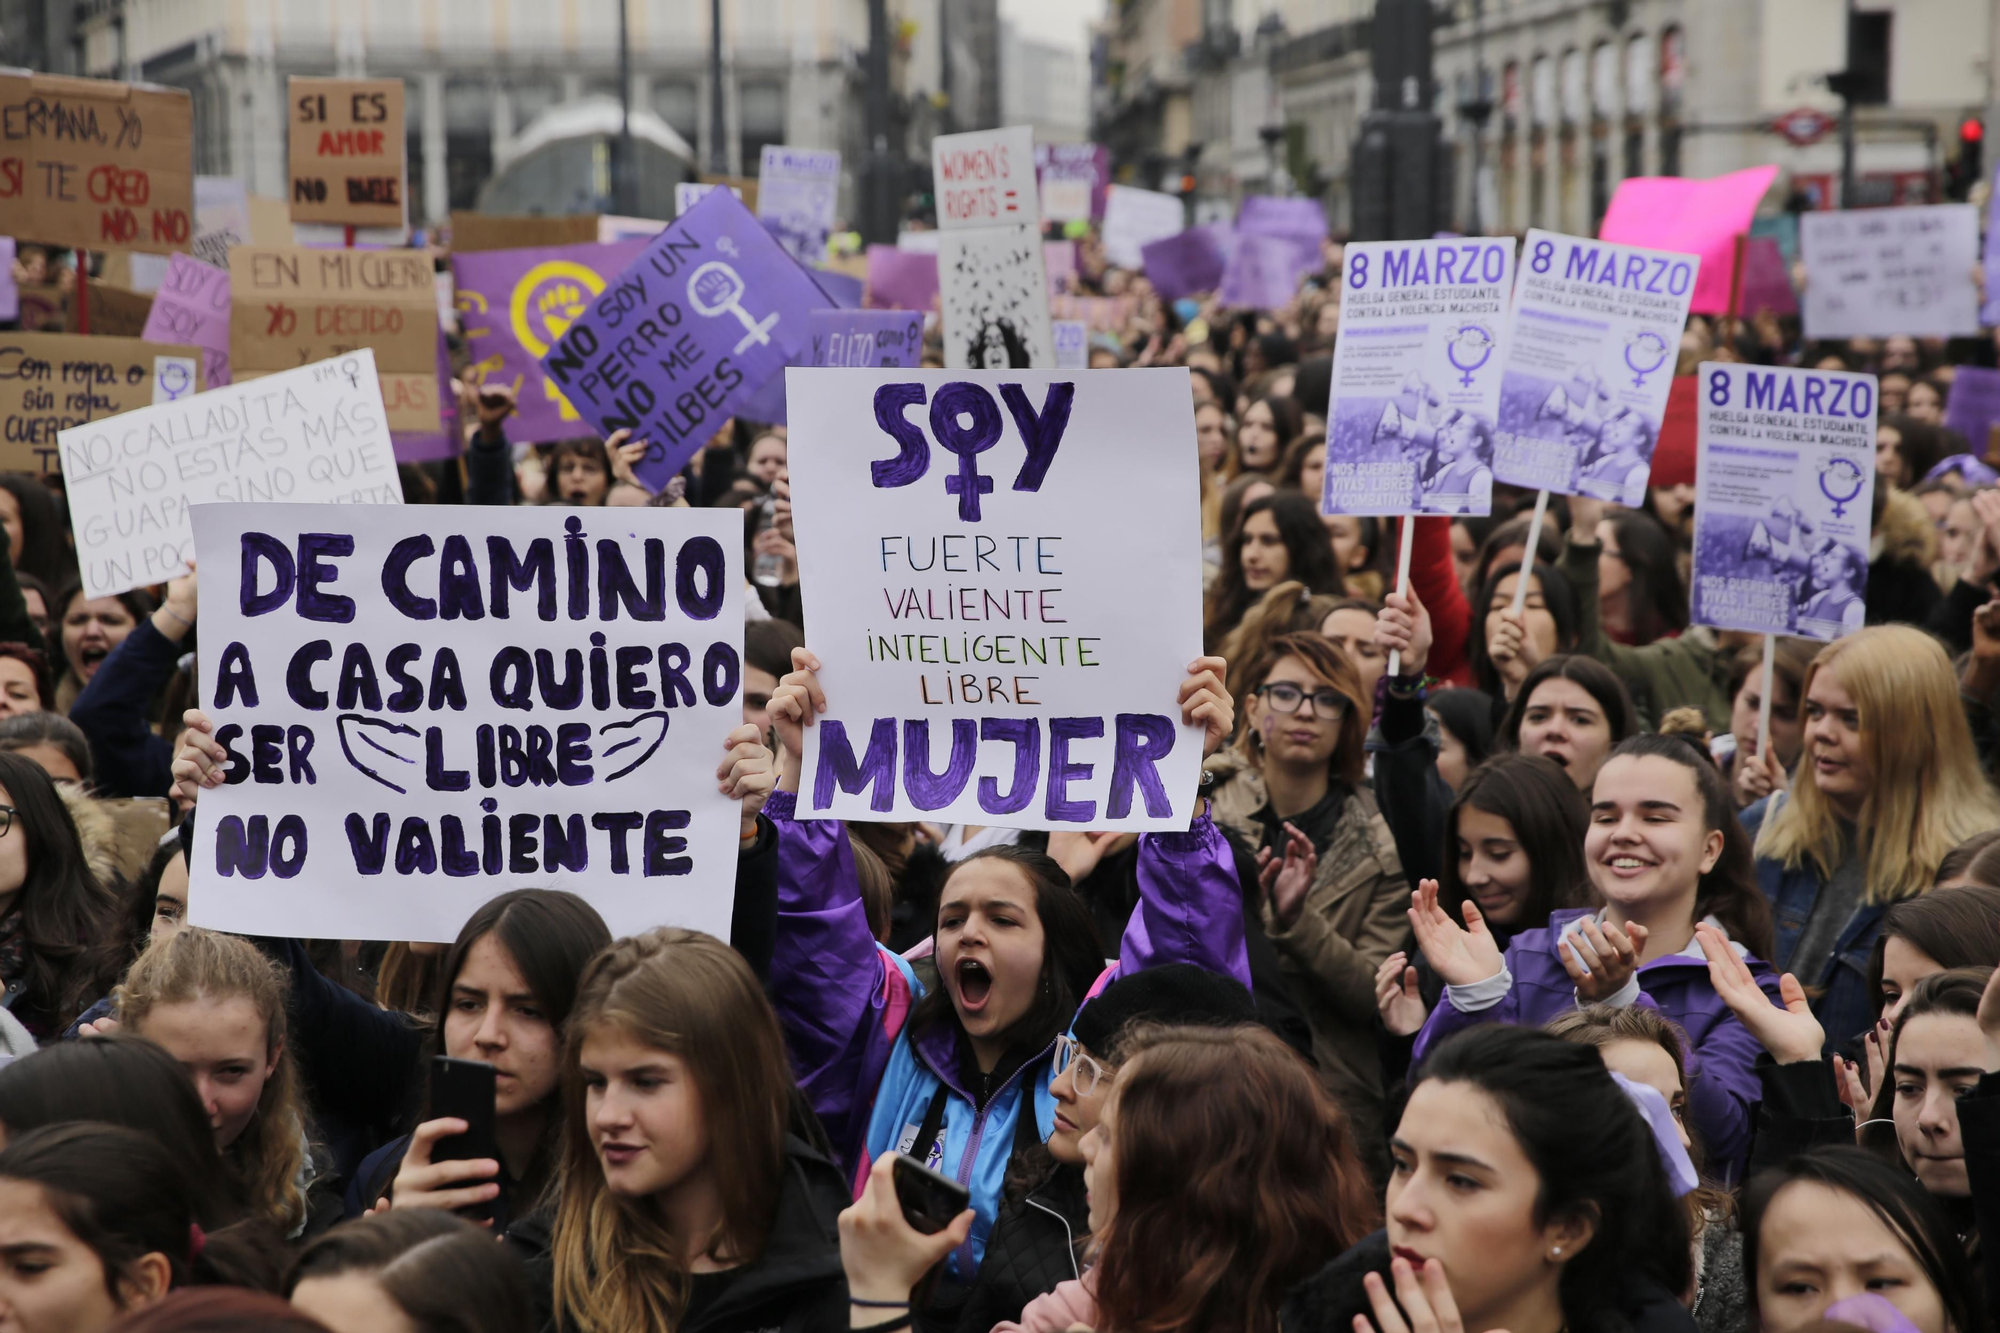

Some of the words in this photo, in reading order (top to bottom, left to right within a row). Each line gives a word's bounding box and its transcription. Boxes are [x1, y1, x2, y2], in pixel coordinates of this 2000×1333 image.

[299, 94, 326, 122] SI
[352, 92, 387, 123] ES
[317, 129, 385, 157] AMOR
[0, 158, 24, 198] SI
[37, 161, 77, 202] TE
[295, 176, 328, 204] NO
[153, 208, 190, 245] NO
[253, 252, 299, 289] EN
[320, 254, 351, 289] MI
[1349, 252, 1369, 289] 8
[1381, 244, 1505, 288] MARZO
[1532, 241, 1554, 274] 8
[1565, 246, 1691, 296] MARZO
[548, 324, 599, 385] NO
[598, 273, 647, 328] SOY
[650, 228, 701, 278] UN
[1347, 292, 1385, 304] HUELGA
[1388, 290, 1429, 302] GENERAL
[1434, 287, 1501, 300] ESTUDIANTIL
[1347, 307, 1382, 318] CONTRA
[1386, 306, 1395, 316] LA
[1400, 304, 1446, 316] VIOLENCIA
[1450, 301, 1499, 314] MACHISTA
[265, 303, 298, 338] YO
[315, 304, 404, 336] DECIDO
[577, 302, 682, 406] PERRO
[63, 361, 118, 396] ropa
[602, 379, 656, 438] NO
[659, 332, 705, 382] ME
[1709, 369, 1731, 407] 8
[1745, 371, 1873, 419] MARZO
[22, 386, 54, 412] sin
[66, 392, 120, 420] ropa
[5, 414, 88, 444] CUERP
[1709, 411, 1749, 424] HUELGA
[1753, 413, 1798, 428] GENERAL
[1803, 417, 1868, 435] ESTUDIANTIL
[1709, 424, 1747, 437] CONTRA
[1751, 427, 1762, 438] LA
[1766, 428, 1816, 443] VIOLENCIA
[1820, 433, 1869, 448] MACHISTA
[108, 460, 167, 503] NO
[302, 397, 377, 450] MÁS
[307, 441, 386, 484] QUE
[870, 381, 1075, 522] SOY
[1332, 462, 1355, 476] NOS
[1357, 462, 1416, 477] QUEREMOS
[1373, 476, 1414, 491] LIBRES
[1343, 493, 1414, 508] COMBATIVAS
[89, 551, 134, 591] UN
[880, 535, 1063, 575] FUERTE
[240, 531, 356, 623] DE
[1702, 575, 1726, 589] NOS
[1729, 577, 1790, 597] QUEREMOS
[1713, 606, 1789, 627] COMBATIVAS
[213, 641, 259, 708] A
[286, 639, 467, 713] CASA
[217, 724, 316, 785] SER
[425, 722, 595, 792] LIBRE
[813, 713, 1176, 823] MUJER
[215, 814, 308, 879] NO
